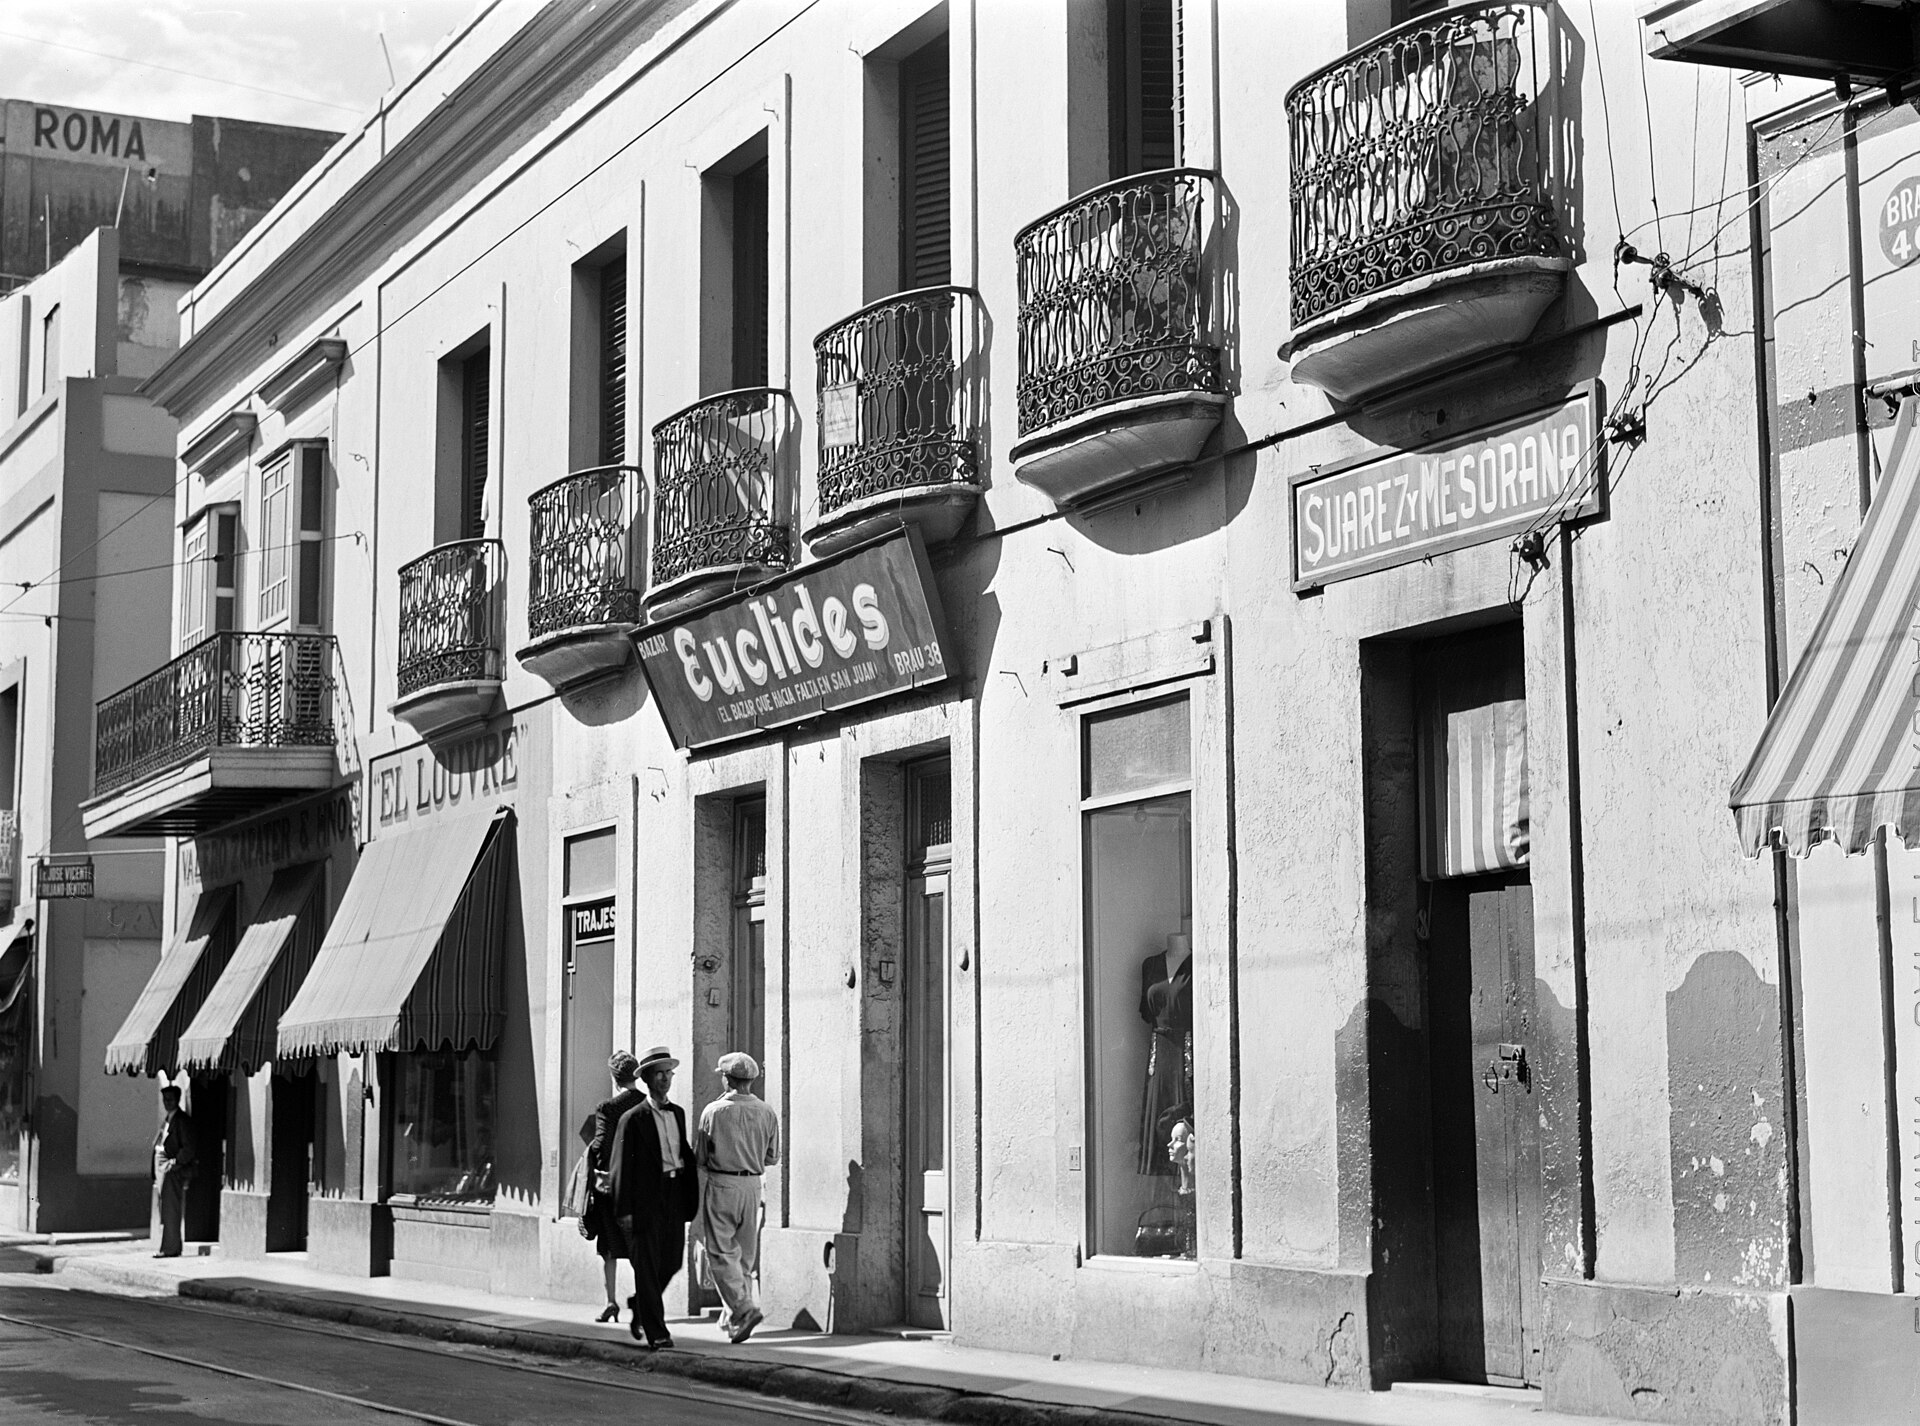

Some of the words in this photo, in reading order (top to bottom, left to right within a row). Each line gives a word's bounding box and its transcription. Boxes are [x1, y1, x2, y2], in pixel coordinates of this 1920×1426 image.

[34, 108, 146, 161] ROMA
[1304, 473, 1410, 567] SUAREZ
[1406, 489, 1419, 522] Y
[1421, 424, 1581, 531] MESORANA
[637, 634, 669, 660] BAZAR
[674, 583, 890, 702] Euclides
[893, 647, 925, 676] BRAU
[924, 641, 942, 667] 38
[730, 699, 757, 720] BAZAR
[755, 693, 774, 715] QUE
[771, 687, 796, 709] HACIA
[795, 679, 820, 702] FALTA
[817, 675, 831, 695] EN
[830, 668, 851, 690] SAN
[576, 906, 615, 933] TRAJES
